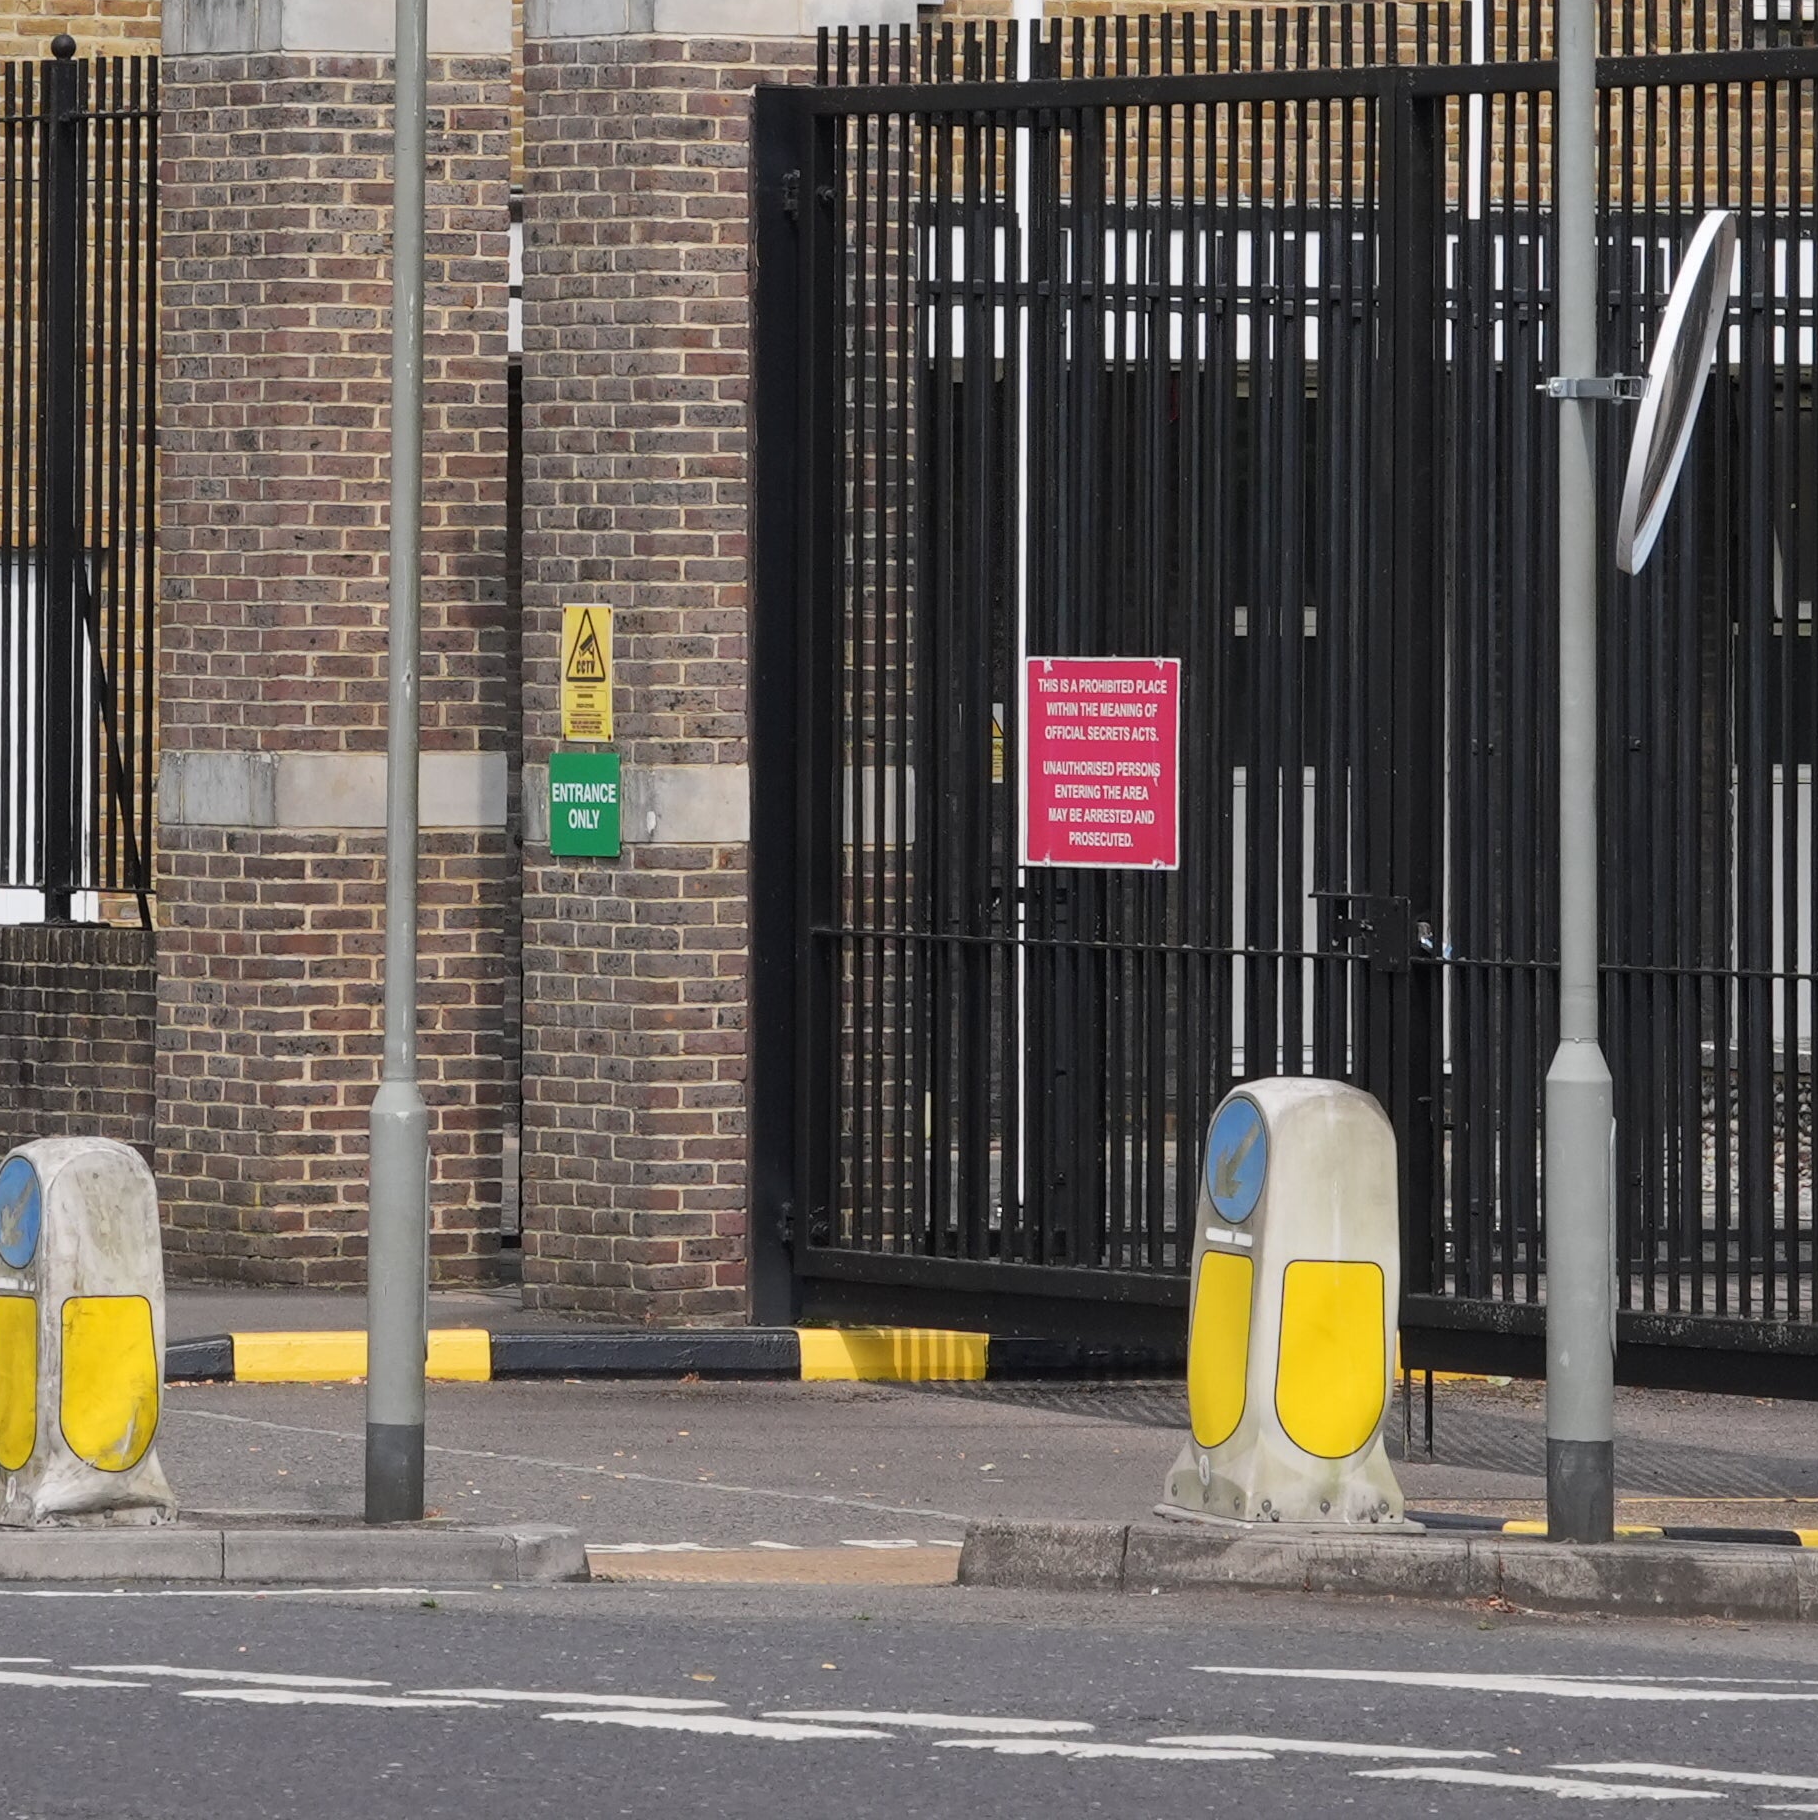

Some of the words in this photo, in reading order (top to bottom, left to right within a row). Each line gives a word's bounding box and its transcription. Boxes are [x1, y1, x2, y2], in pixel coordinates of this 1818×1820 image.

[576, 660, 596, 675] CCTV
[1038, 678, 1058, 693] THIS
[1060, 679, 1069, 693] IS
[1070, 679, 1078, 693] A
[1079, 679, 1135, 694] PROHIBITED
[1136, 679, 1167, 694] PLACE
[1046, 702, 1078, 716] WITHIN
[1080, 702, 1098, 717] THE
[1100, 702, 1143, 717] MEANING
[1144, 703, 1158, 718] OF
[1045, 725, 1086, 740] OFFICIAL
[1087, 726, 1130, 741] SECRETS
[1131, 727, 1160, 742] ACTS.
[1043, 760, 1115, 776] UNAUTHORISED
[1116, 762, 1161, 777] PERSONS
[552, 782, 617, 804] ENTRANCE
[1054, 784, 1101, 799] ENTERING
[1102, 785, 1121, 800] THE
[1122, 786, 1149, 800] AREA
[568, 808, 600, 830] ONLY
[1048, 807, 1068, 822] MAY
[1069, 808, 1083, 822] BE
[1083, 808, 1133, 824] ARRESTED
[1134, 809, 1155, 825] AND
[1069, 831, 1134, 848] PROSECUTED.
